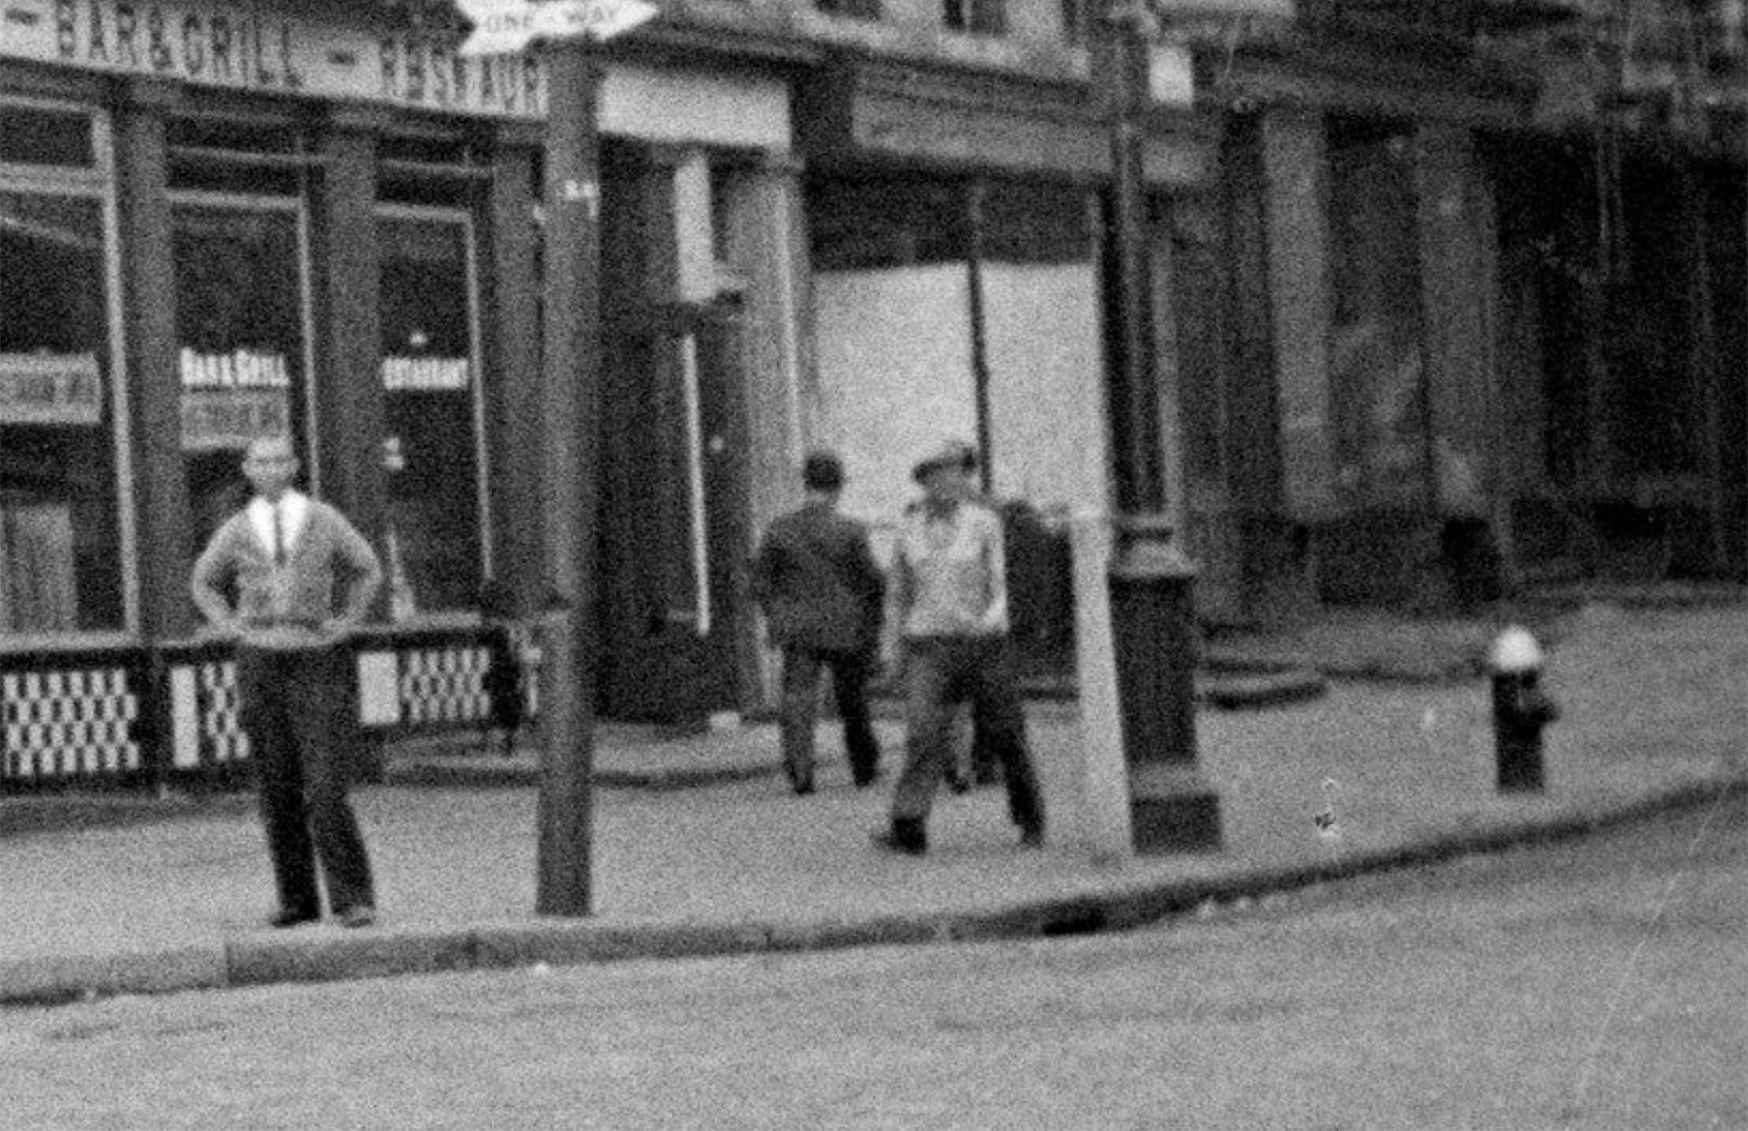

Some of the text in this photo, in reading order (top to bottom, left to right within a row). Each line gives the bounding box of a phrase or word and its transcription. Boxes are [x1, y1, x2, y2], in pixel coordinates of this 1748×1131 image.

[485, 6, 616, 34] ONE WAY
[380, 37, 541, 115] RESTAUR
